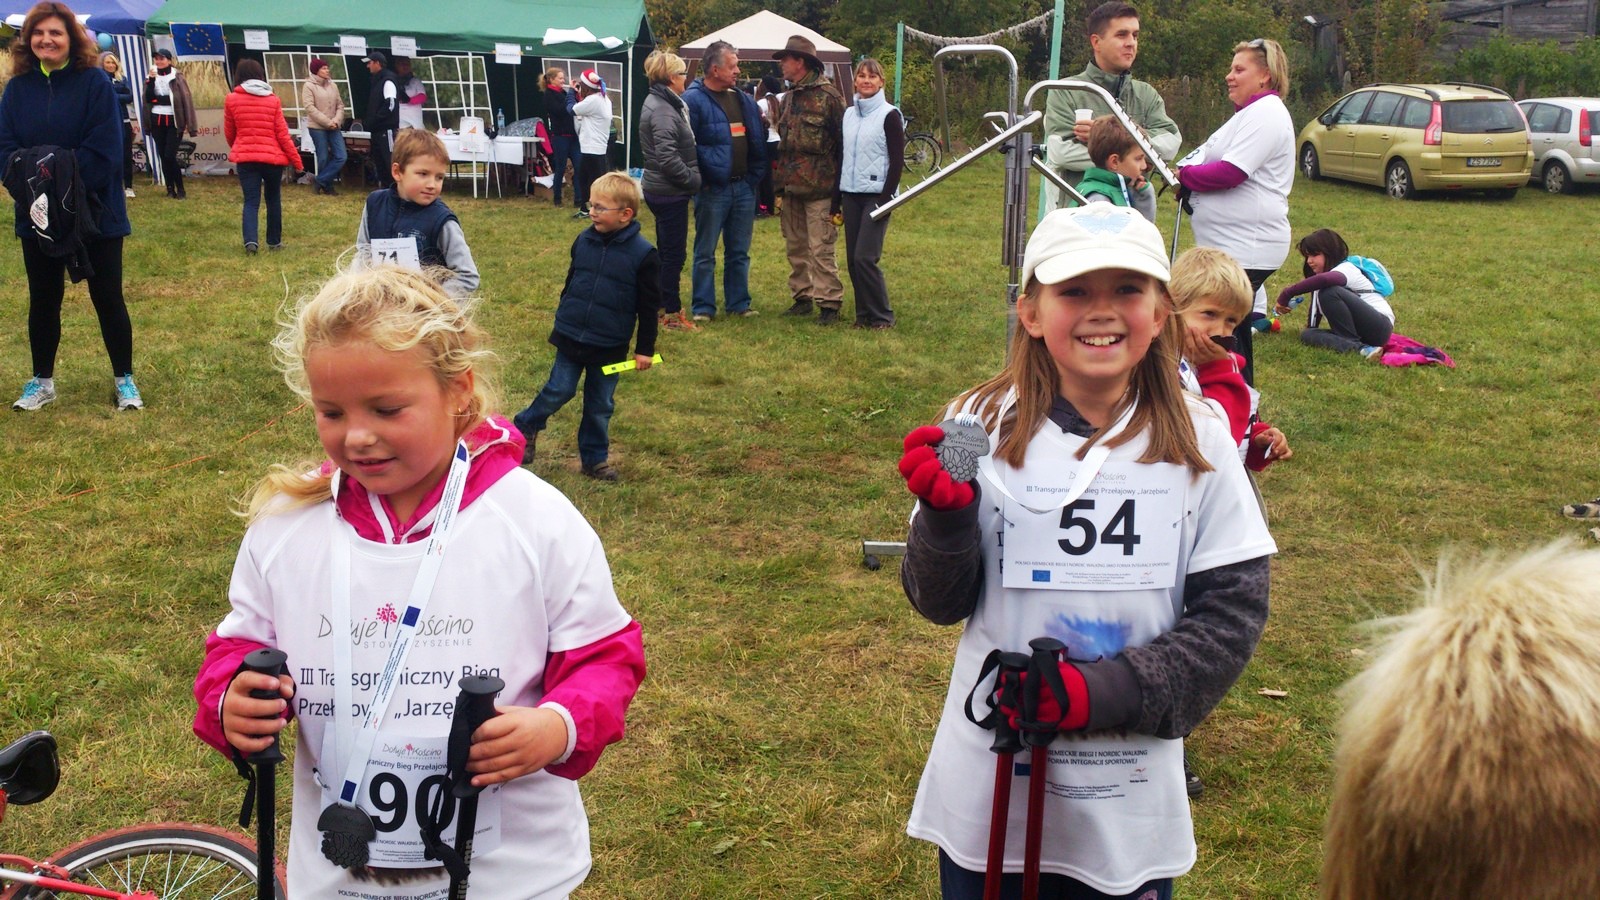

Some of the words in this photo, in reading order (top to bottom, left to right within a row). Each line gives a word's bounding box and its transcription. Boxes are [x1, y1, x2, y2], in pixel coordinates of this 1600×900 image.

[194, 152, 228, 161] ROZWO
[1101, 487, 1136, 496] Przełajowy
[1057, 498, 1141, 556] 54
[300, 667, 314, 686] III
[396, 762, 412, 772] Bieg
[413, 762, 448, 772] Przełajow
[369, 772, 456, 833] 90
